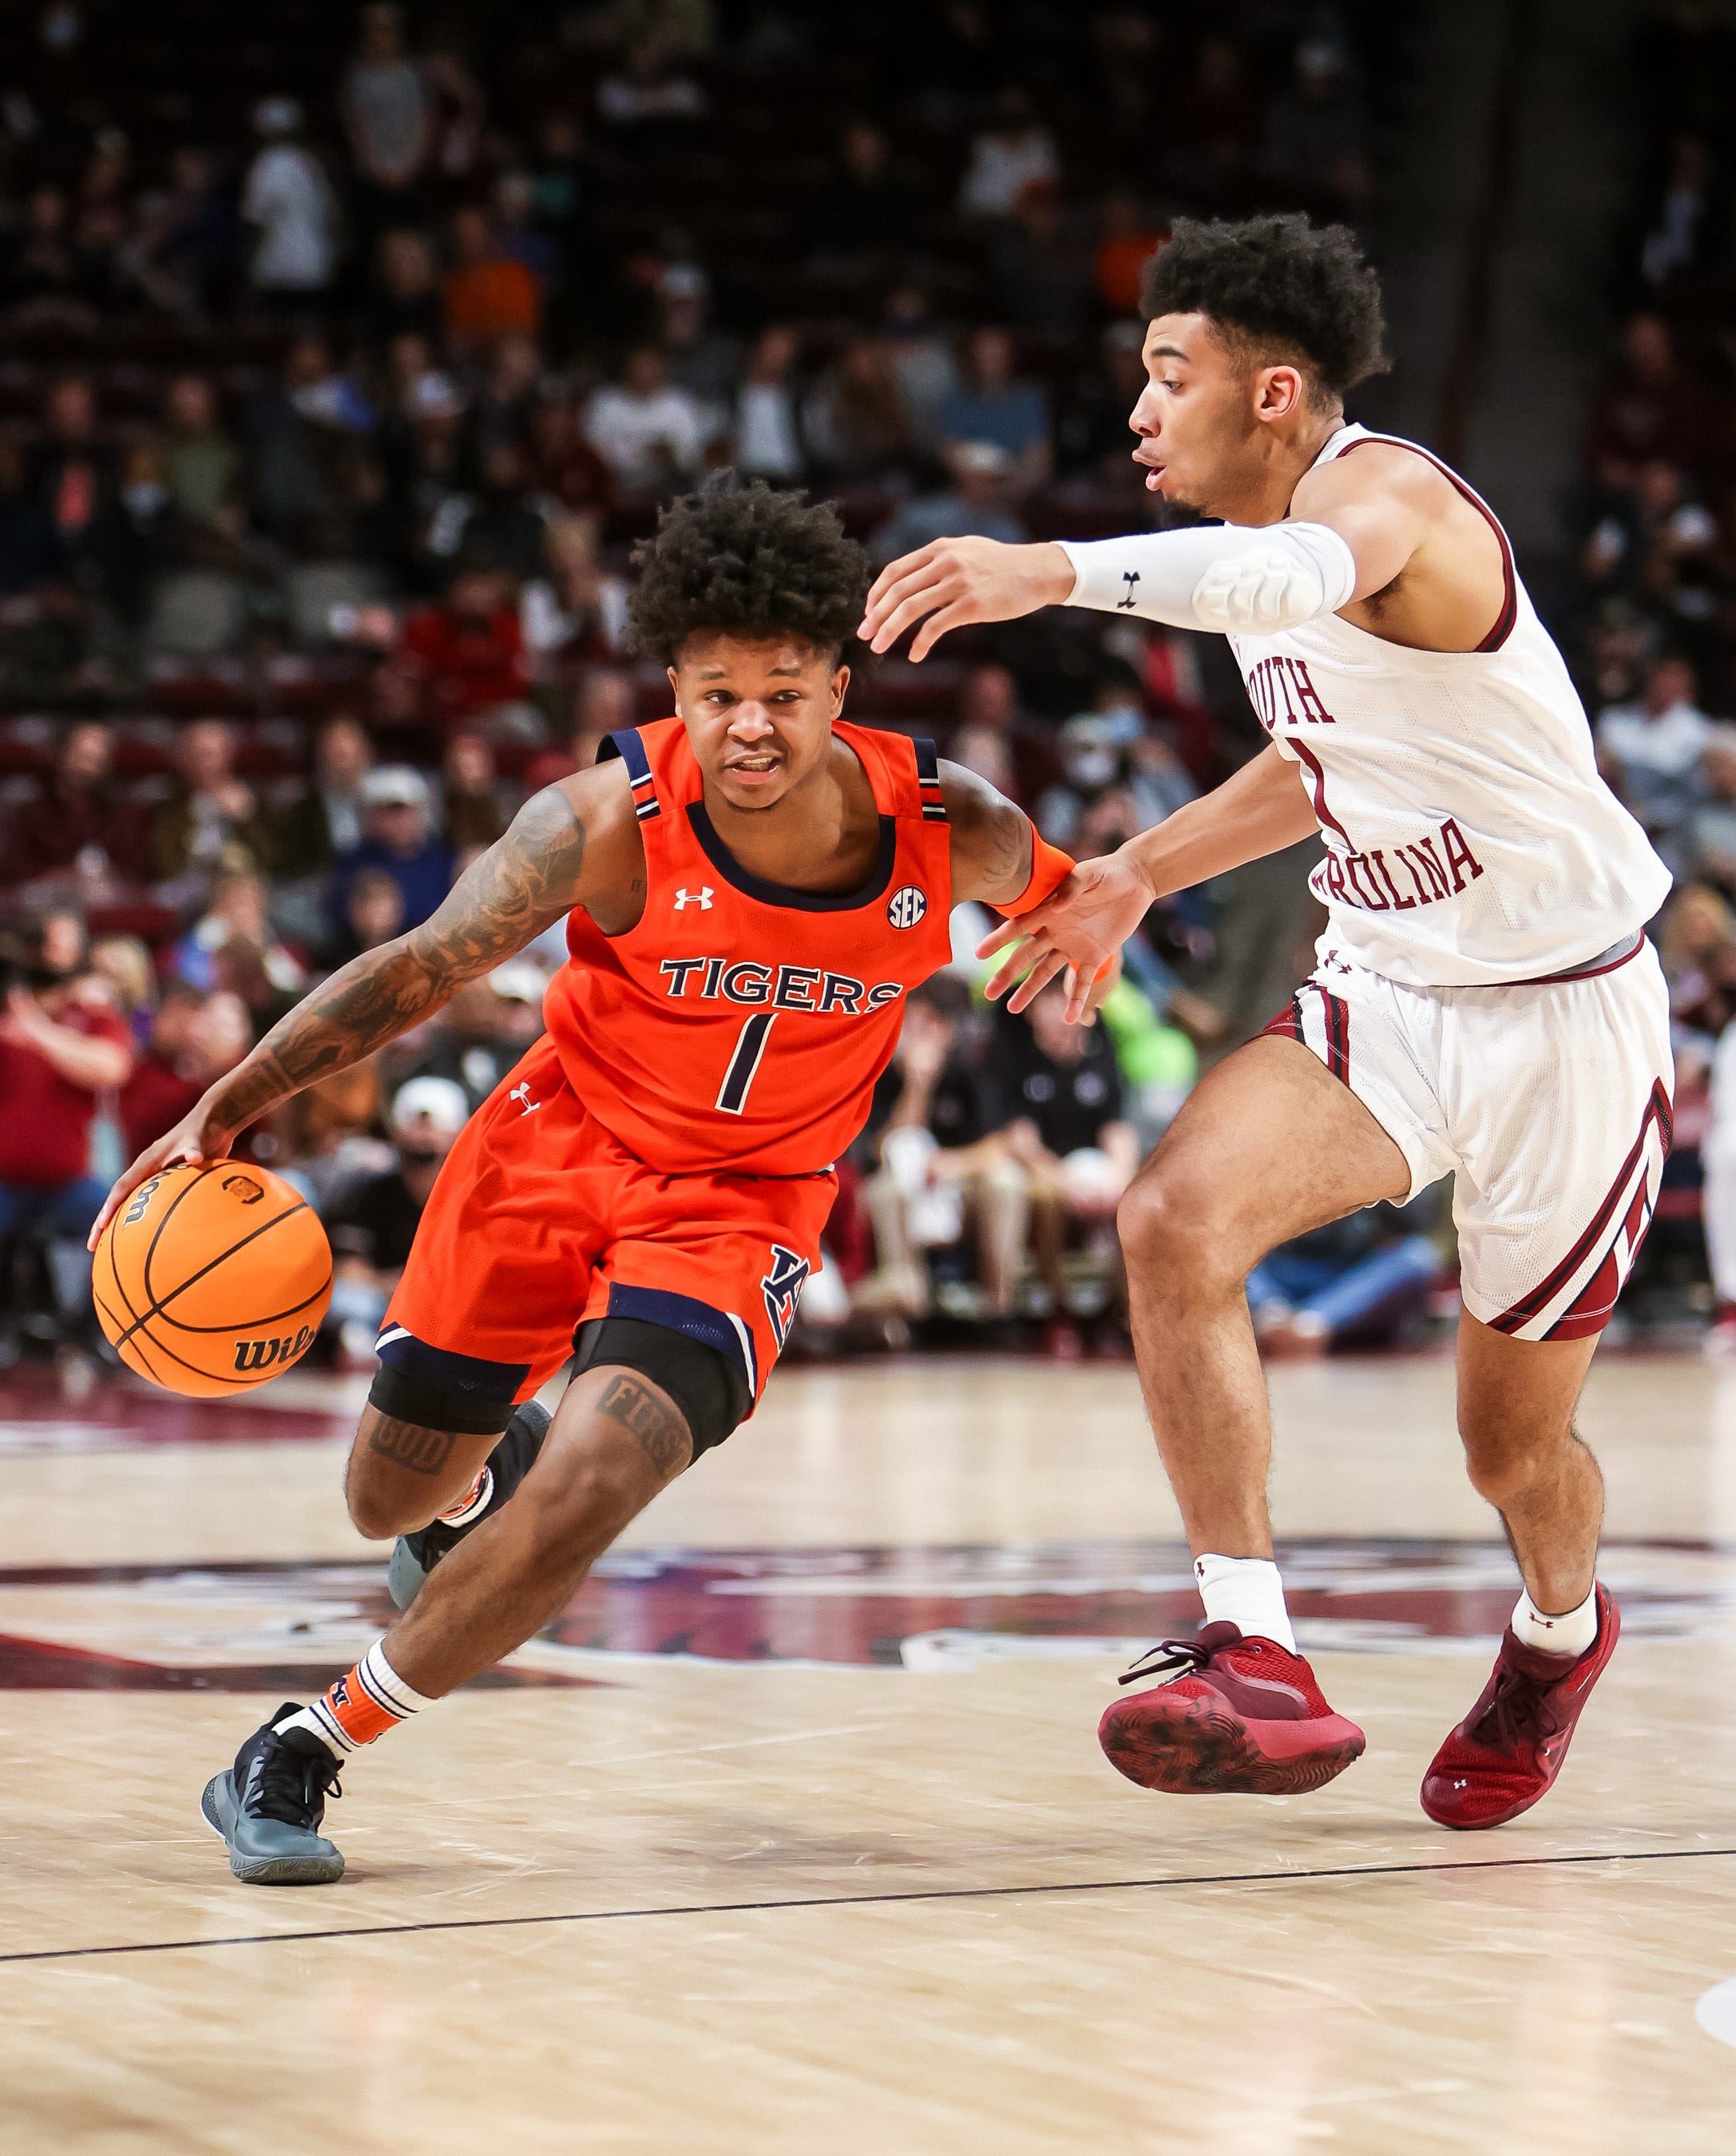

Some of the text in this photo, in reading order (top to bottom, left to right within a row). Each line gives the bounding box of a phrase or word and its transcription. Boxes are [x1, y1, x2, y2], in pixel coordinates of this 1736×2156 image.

[1248, 656, 1337, 731] OUTH
[1311, 817, 1484, 911] ROLINA
[888, 886, 926, 929] SEC
[658, 956, 904, 1016] TIGERS
[714, 1012, 780, 1116] 1
